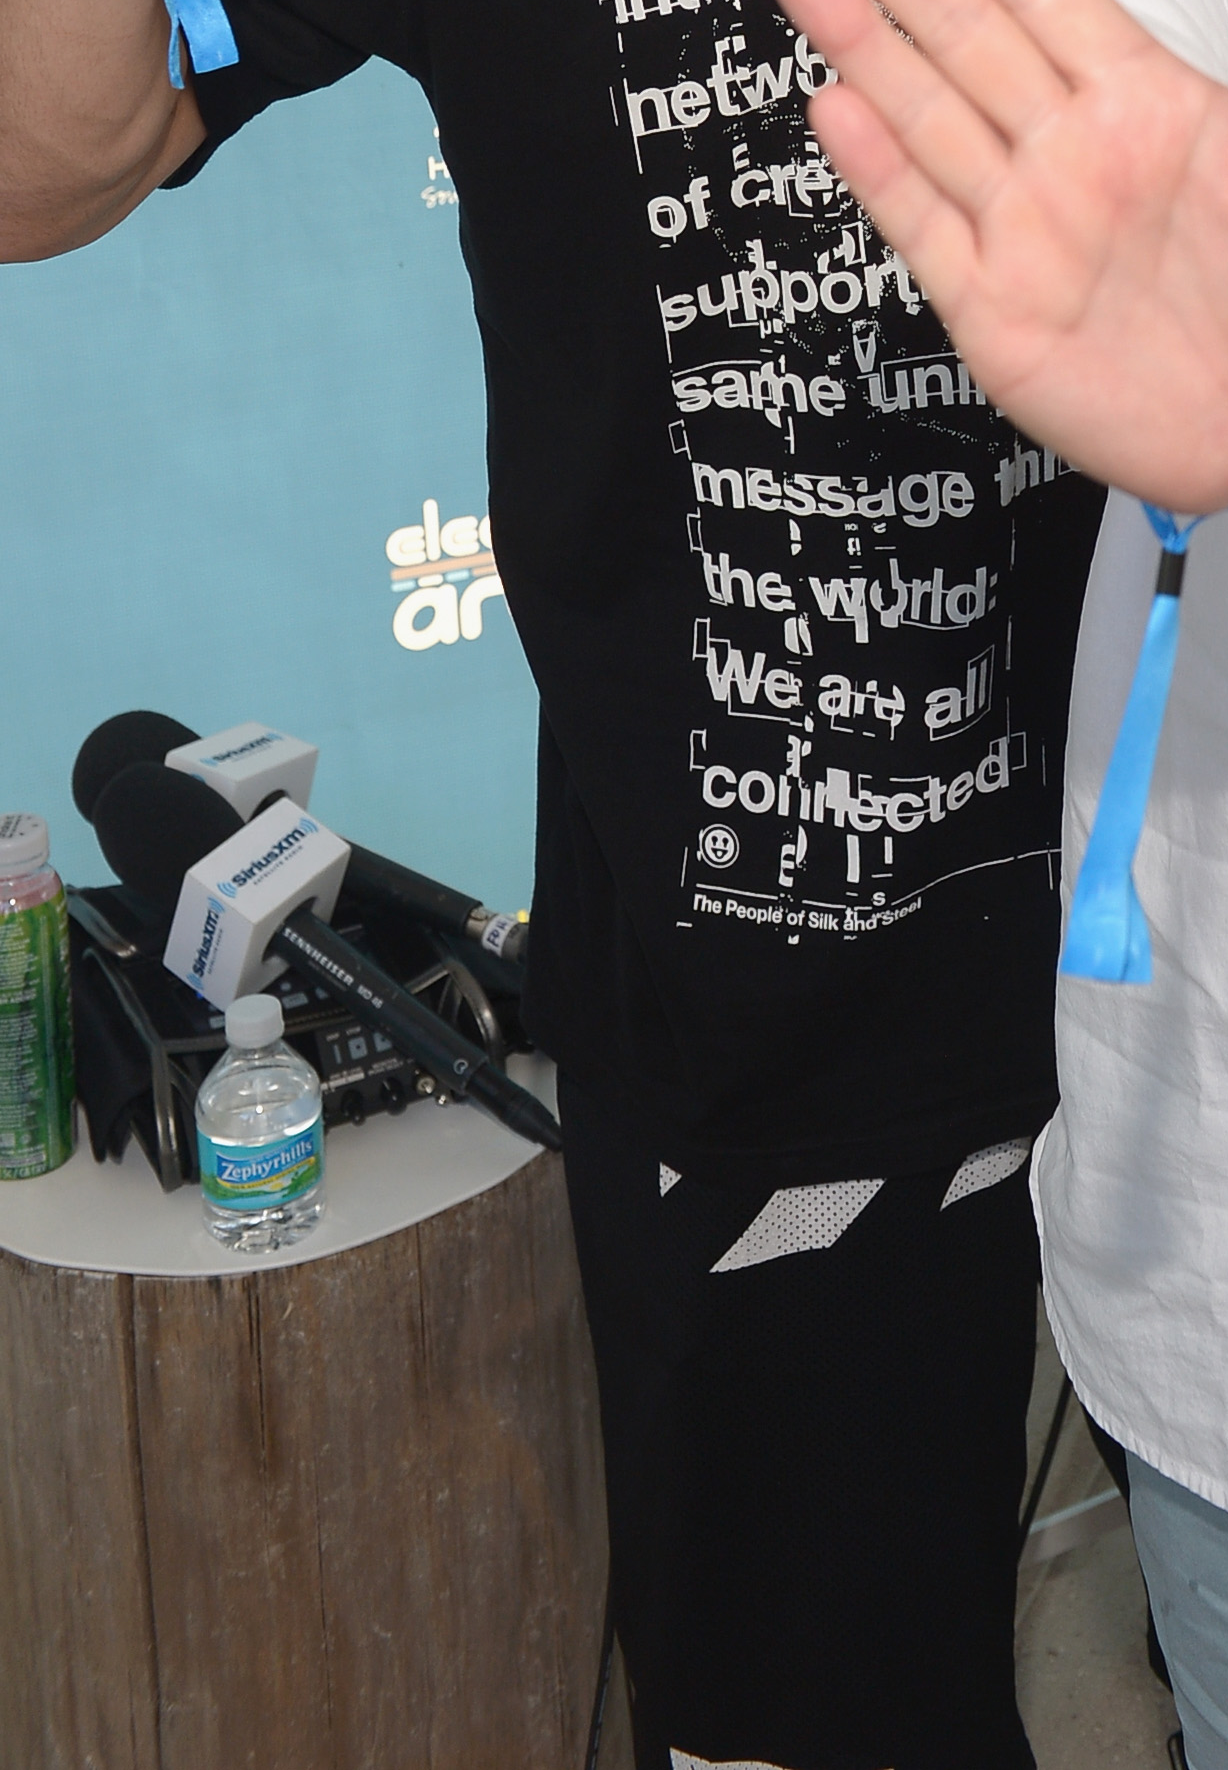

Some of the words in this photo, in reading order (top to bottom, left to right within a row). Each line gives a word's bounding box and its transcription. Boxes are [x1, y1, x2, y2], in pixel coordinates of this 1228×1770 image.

[647, 175, 711, 238] of
[662, 251, 931, 331] support
[673, 364, 847, 417] same
[692, 461, 975, 528] message
[702, 553, 796, 612] the
[706, 647, 803, 708] We
[818, 674, 906, 727] are
[925, 656, 990, 729] all
[693, 892, 723, 914] The
[724, 898, 783, 925] People
[786, 909, 804, 927] of
[807, 908, 840, 932] Silk
[221, 1140, 313, 1181] Zephyrhills
